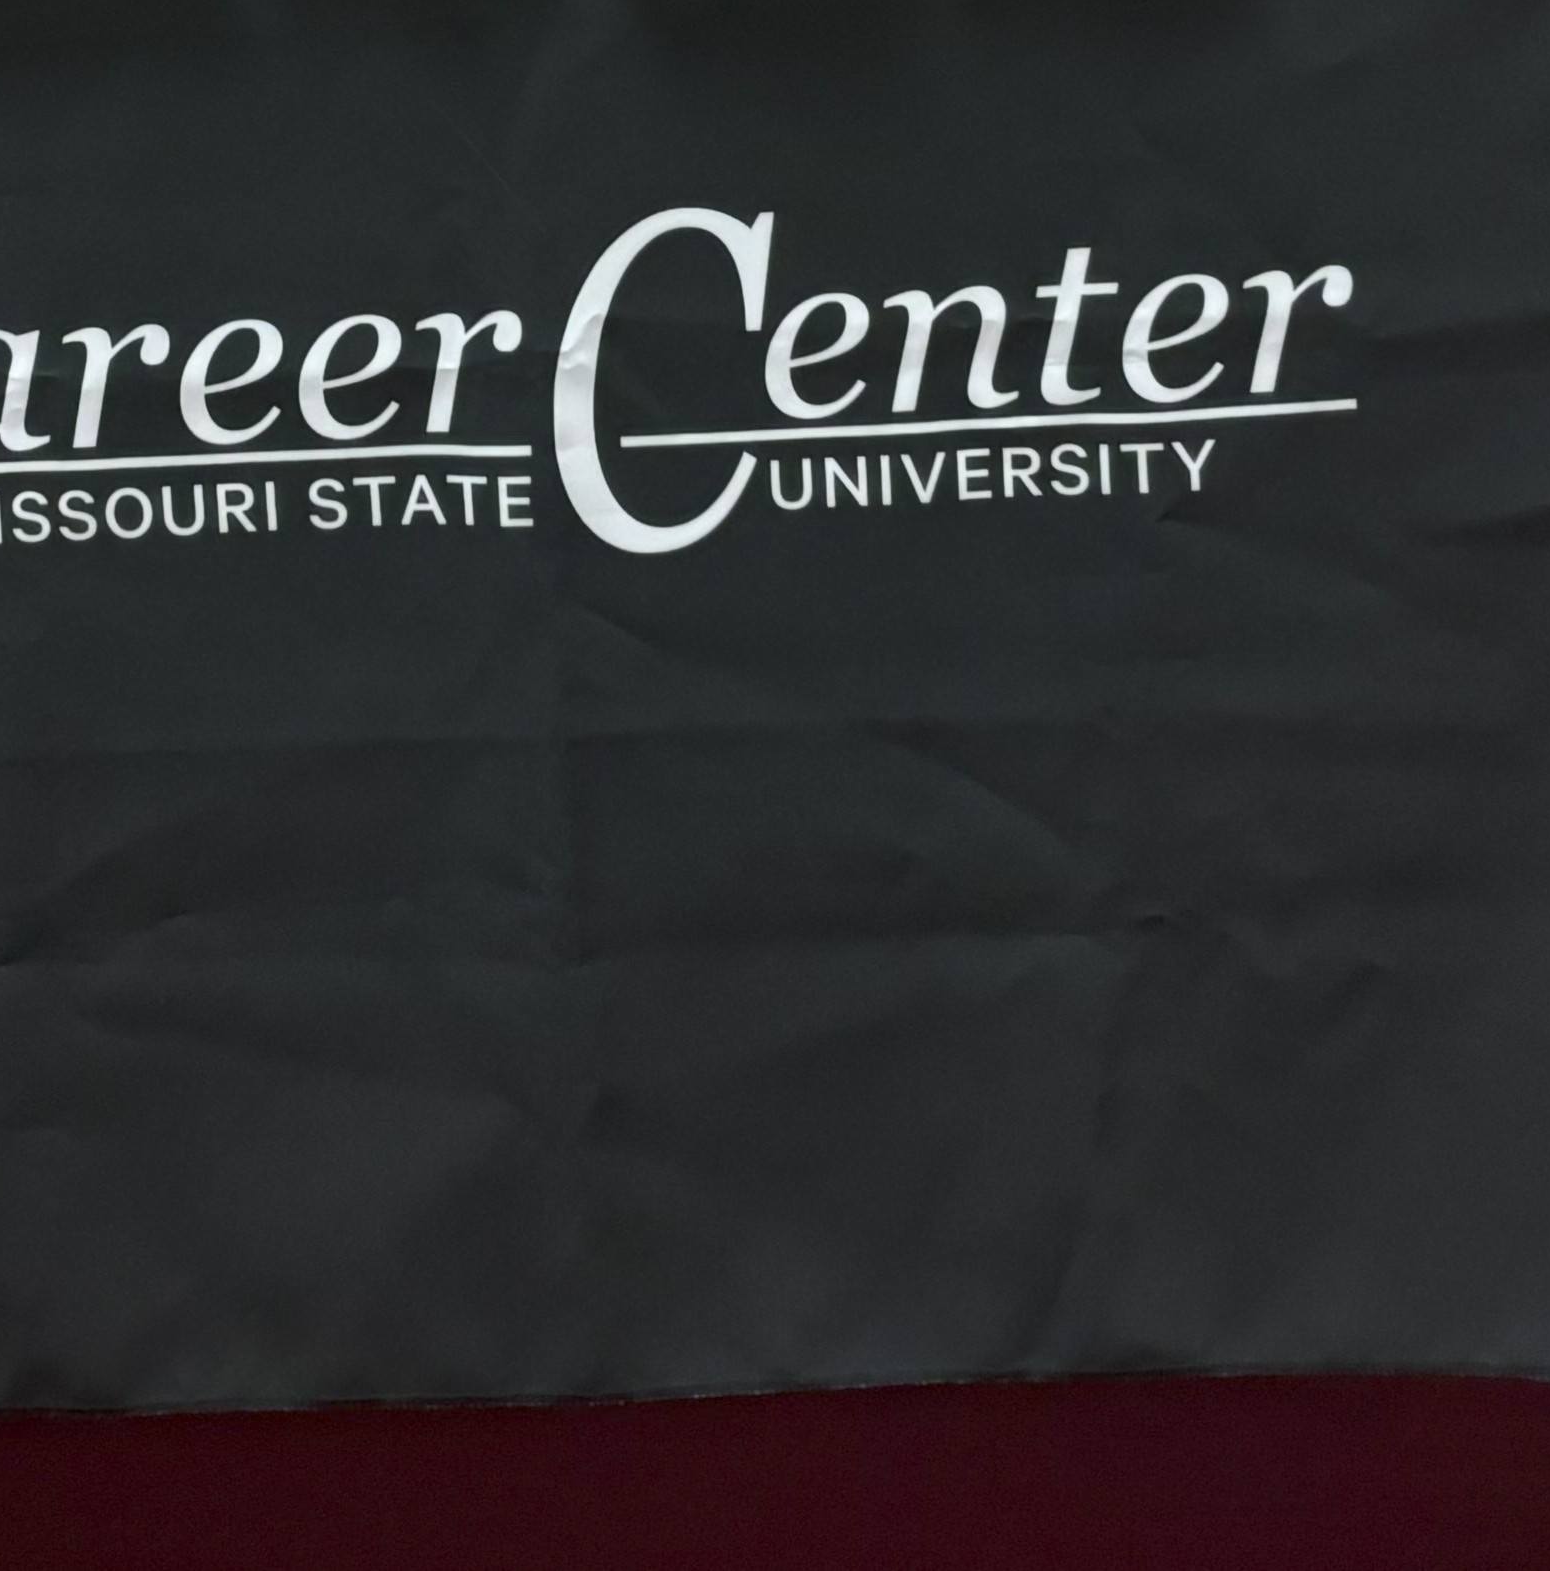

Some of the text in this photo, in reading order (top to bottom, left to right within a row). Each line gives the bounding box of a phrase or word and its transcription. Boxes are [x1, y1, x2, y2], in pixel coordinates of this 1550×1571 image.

[308, 474, 534, 530] STATE
[770, 438, 1216, 511] UNIVERSITY
[553, 207, 1358, 554] Center
